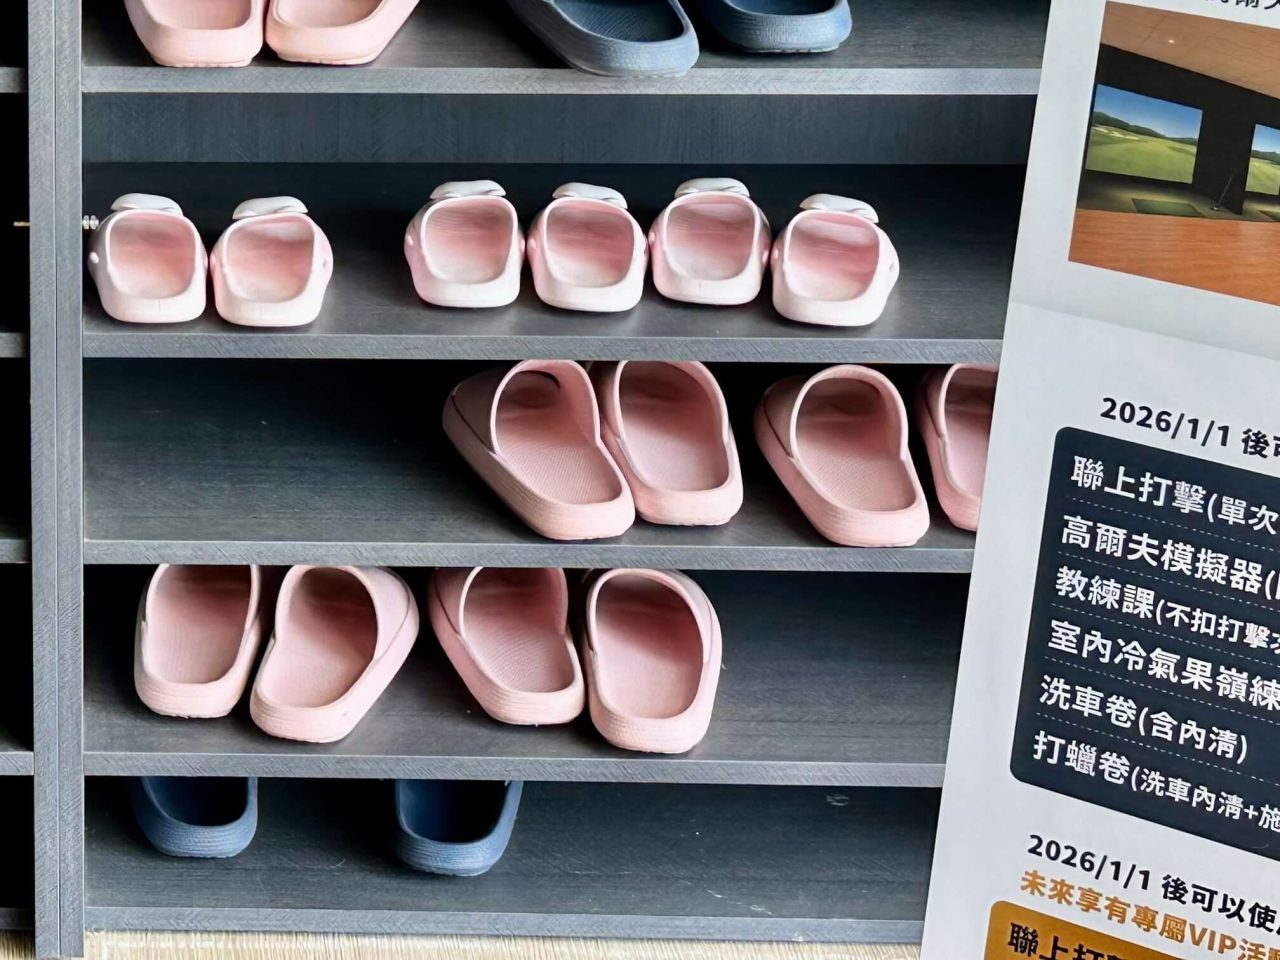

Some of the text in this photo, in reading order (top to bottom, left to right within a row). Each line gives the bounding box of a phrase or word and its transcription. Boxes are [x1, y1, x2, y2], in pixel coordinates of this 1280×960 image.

[1100, 397, 1280, 459] 2026/1/1 後
[1061, 514, 1280, 600] 高爾夫模擬器(
[1027, 834, 1280, 934] 2026/1/1 後可以使
[1007, 921, 1128, 960] 聯上打
